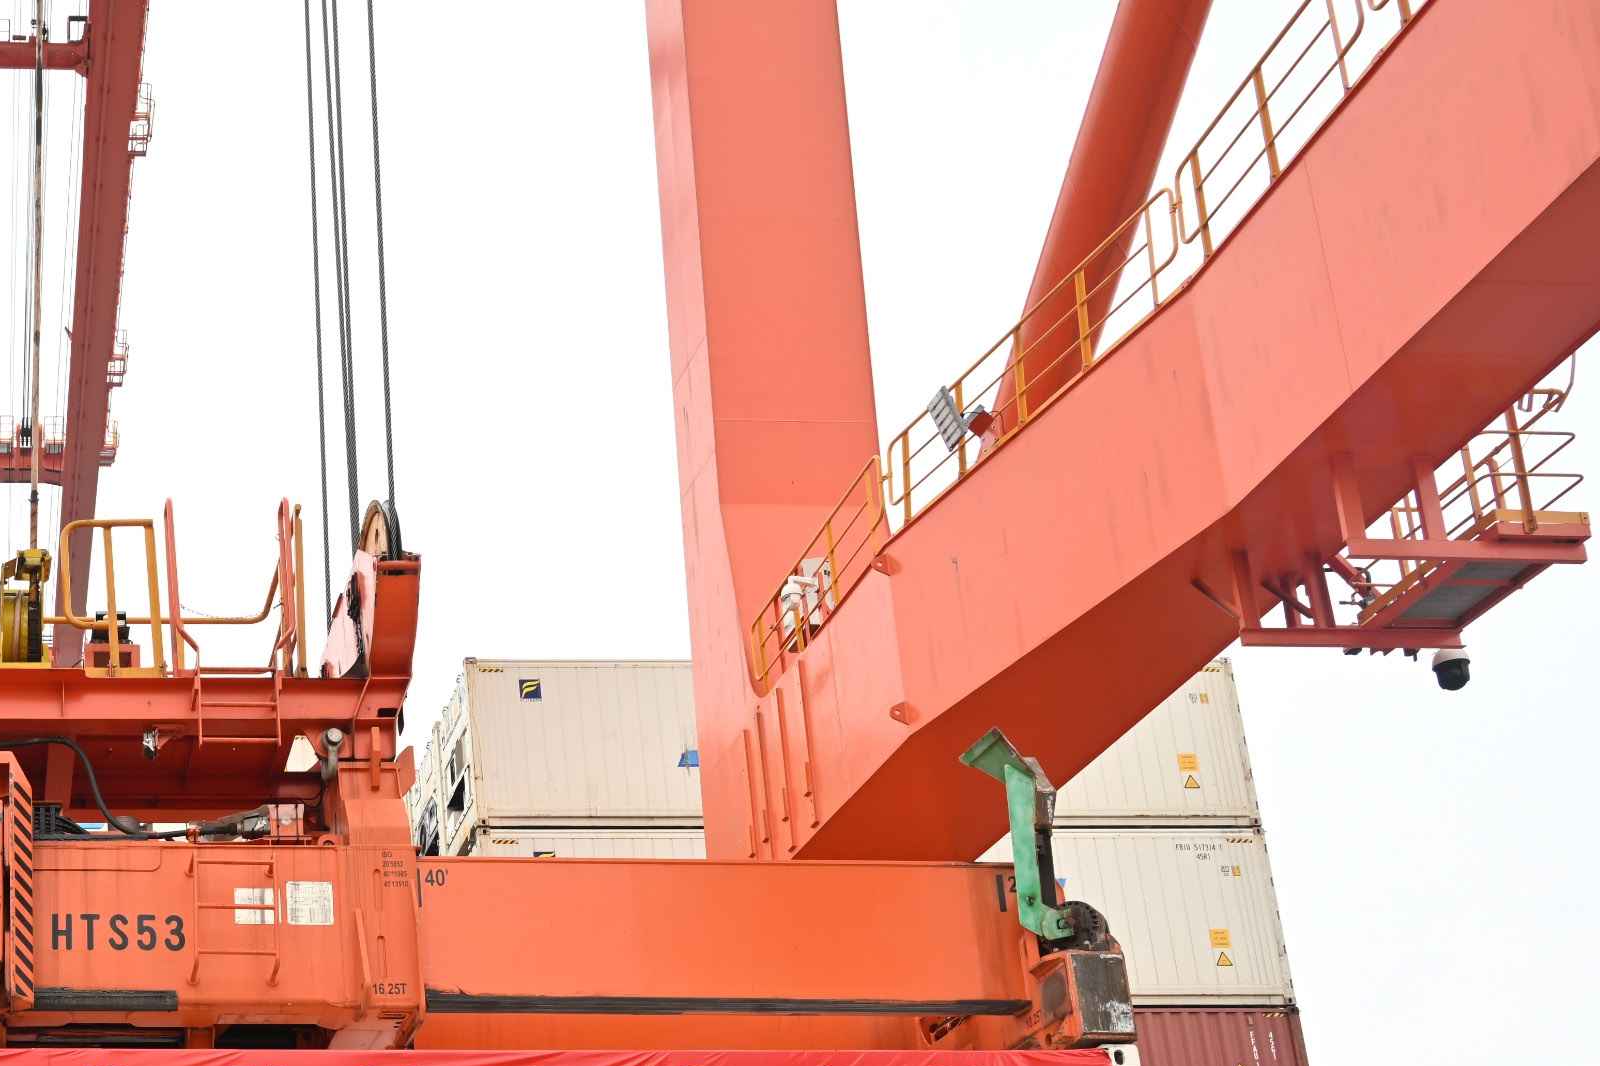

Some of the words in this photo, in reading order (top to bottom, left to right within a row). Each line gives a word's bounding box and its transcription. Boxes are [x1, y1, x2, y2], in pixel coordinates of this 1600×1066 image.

[425, 868, 448, 887] 40'
[51, 913, 185, 951] HTS53
[372, 983, 407, 995] 16.25T
